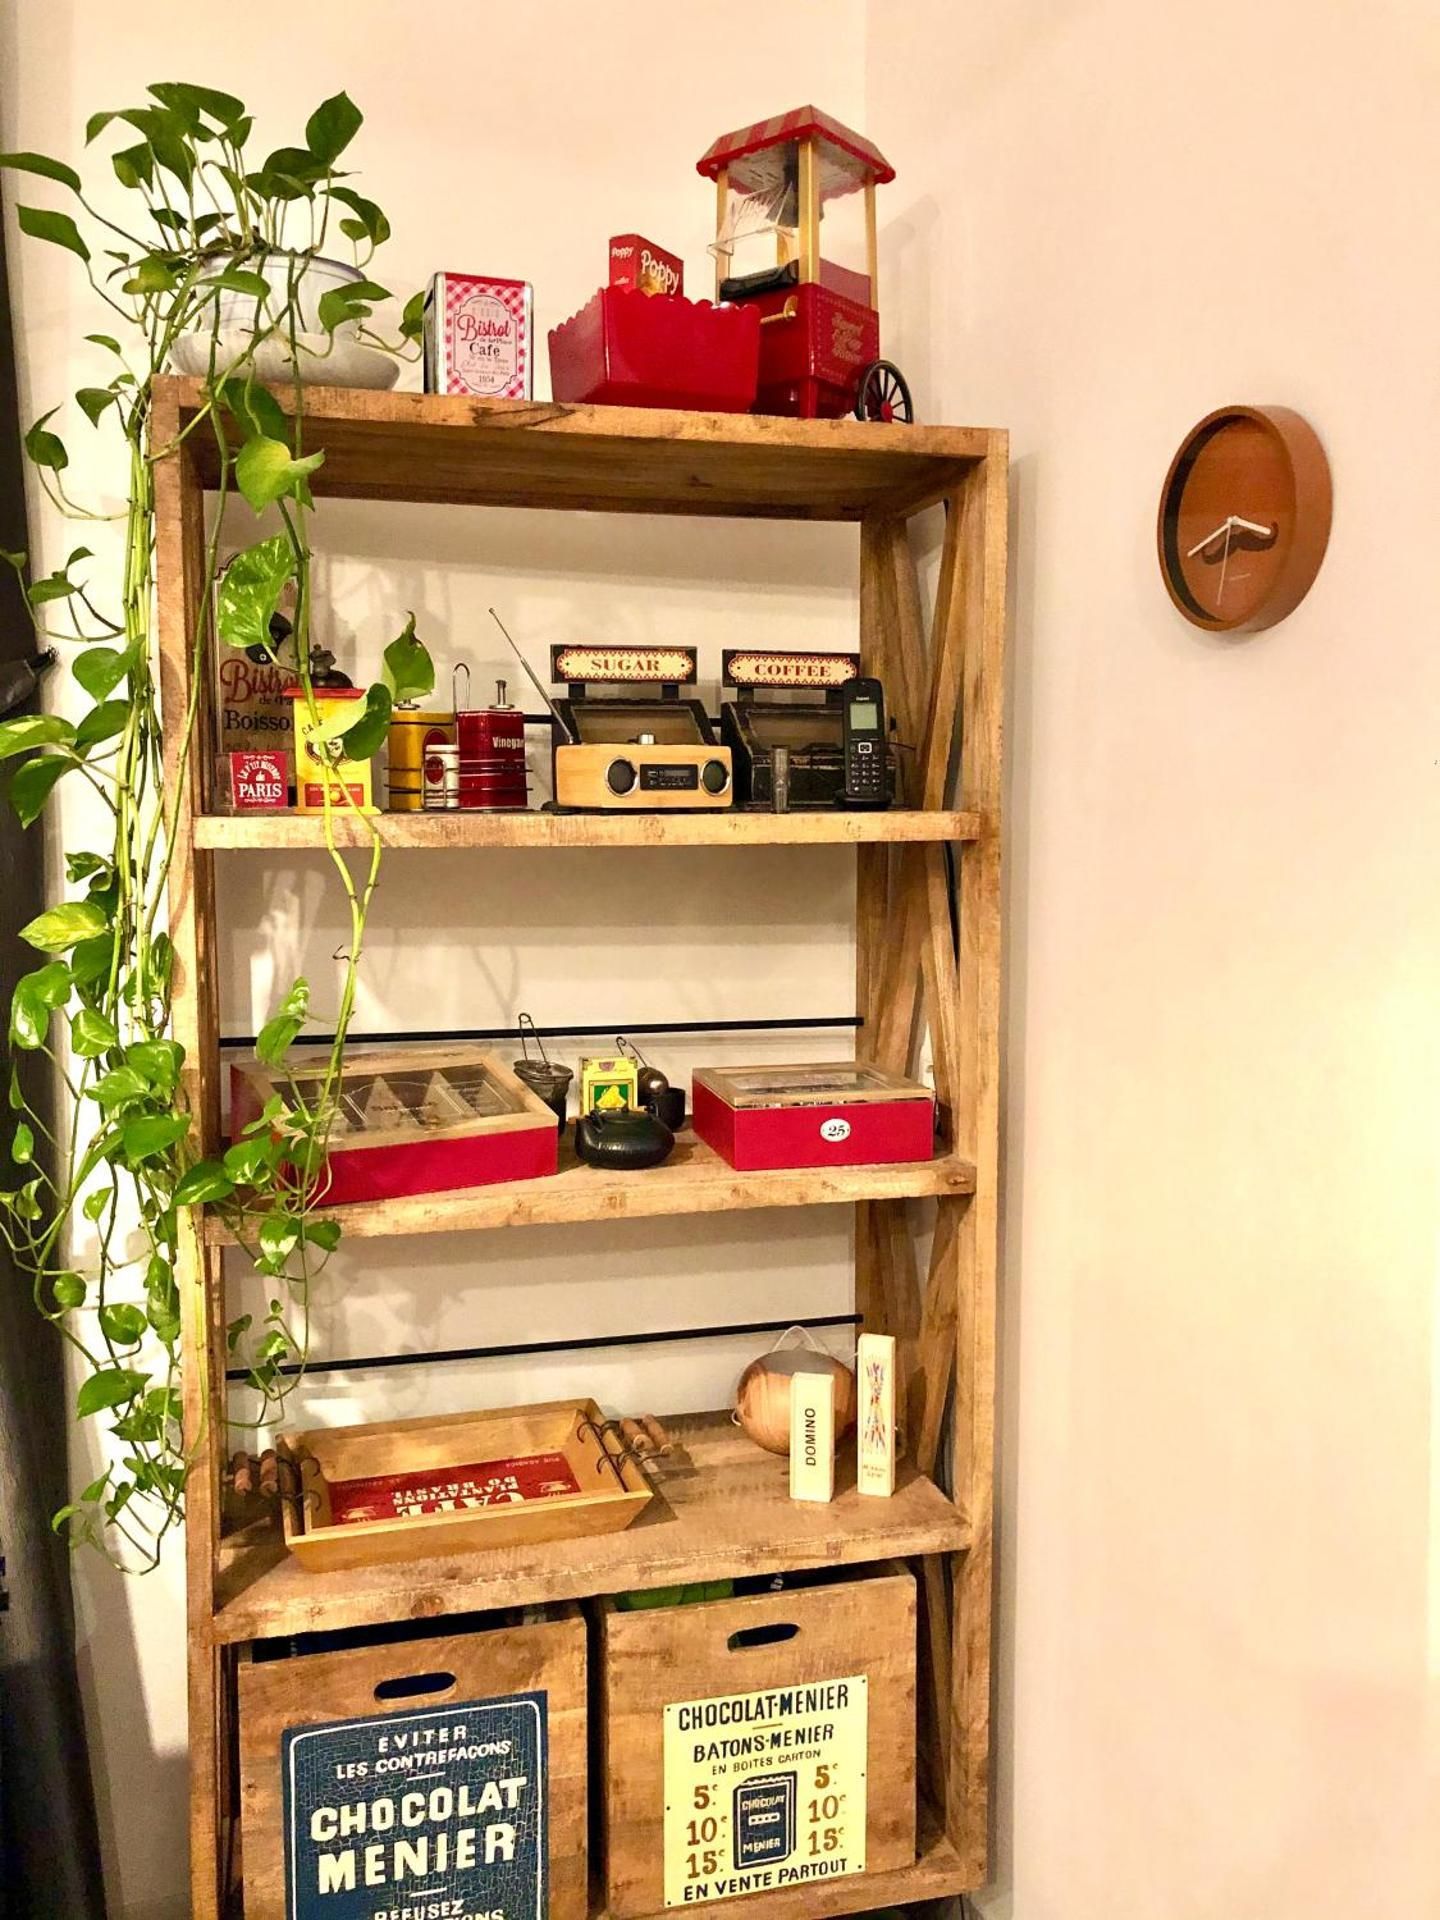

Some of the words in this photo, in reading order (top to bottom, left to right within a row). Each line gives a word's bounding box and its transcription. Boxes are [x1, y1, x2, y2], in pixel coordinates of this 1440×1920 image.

[641, 249, 679, 295] Poppy
[591, 659, 661, 672] SUGAR
[754, 664, 832, 678] COFFEE
[224, 709, 294, 731] Boisso
[238, 783, 283, 798] PARIS
[828, 1124, 845, 1137] 25
[804, 1407, 816, 1466] DOMINO
[378, 1725, 467, 1753] EVITER
[336, 1761, 368, 1780] LES
[712, 1764, 727, 1776] EN
[778, 1749, 821, 1764] CARTON
[310, 1776, 528, 1842] CHOCOLAT
[741, 1795, 785, 1811] CHOCOLAT
[743, 1838, 781, 1854] MENIER
[318, 1822, 516, 1895] MENIER
[683, 1882, 709, 1902] EN
[715, 1871, 772, 1896] VENTE
[778, 1858, 848, 1884] PARTOUT
